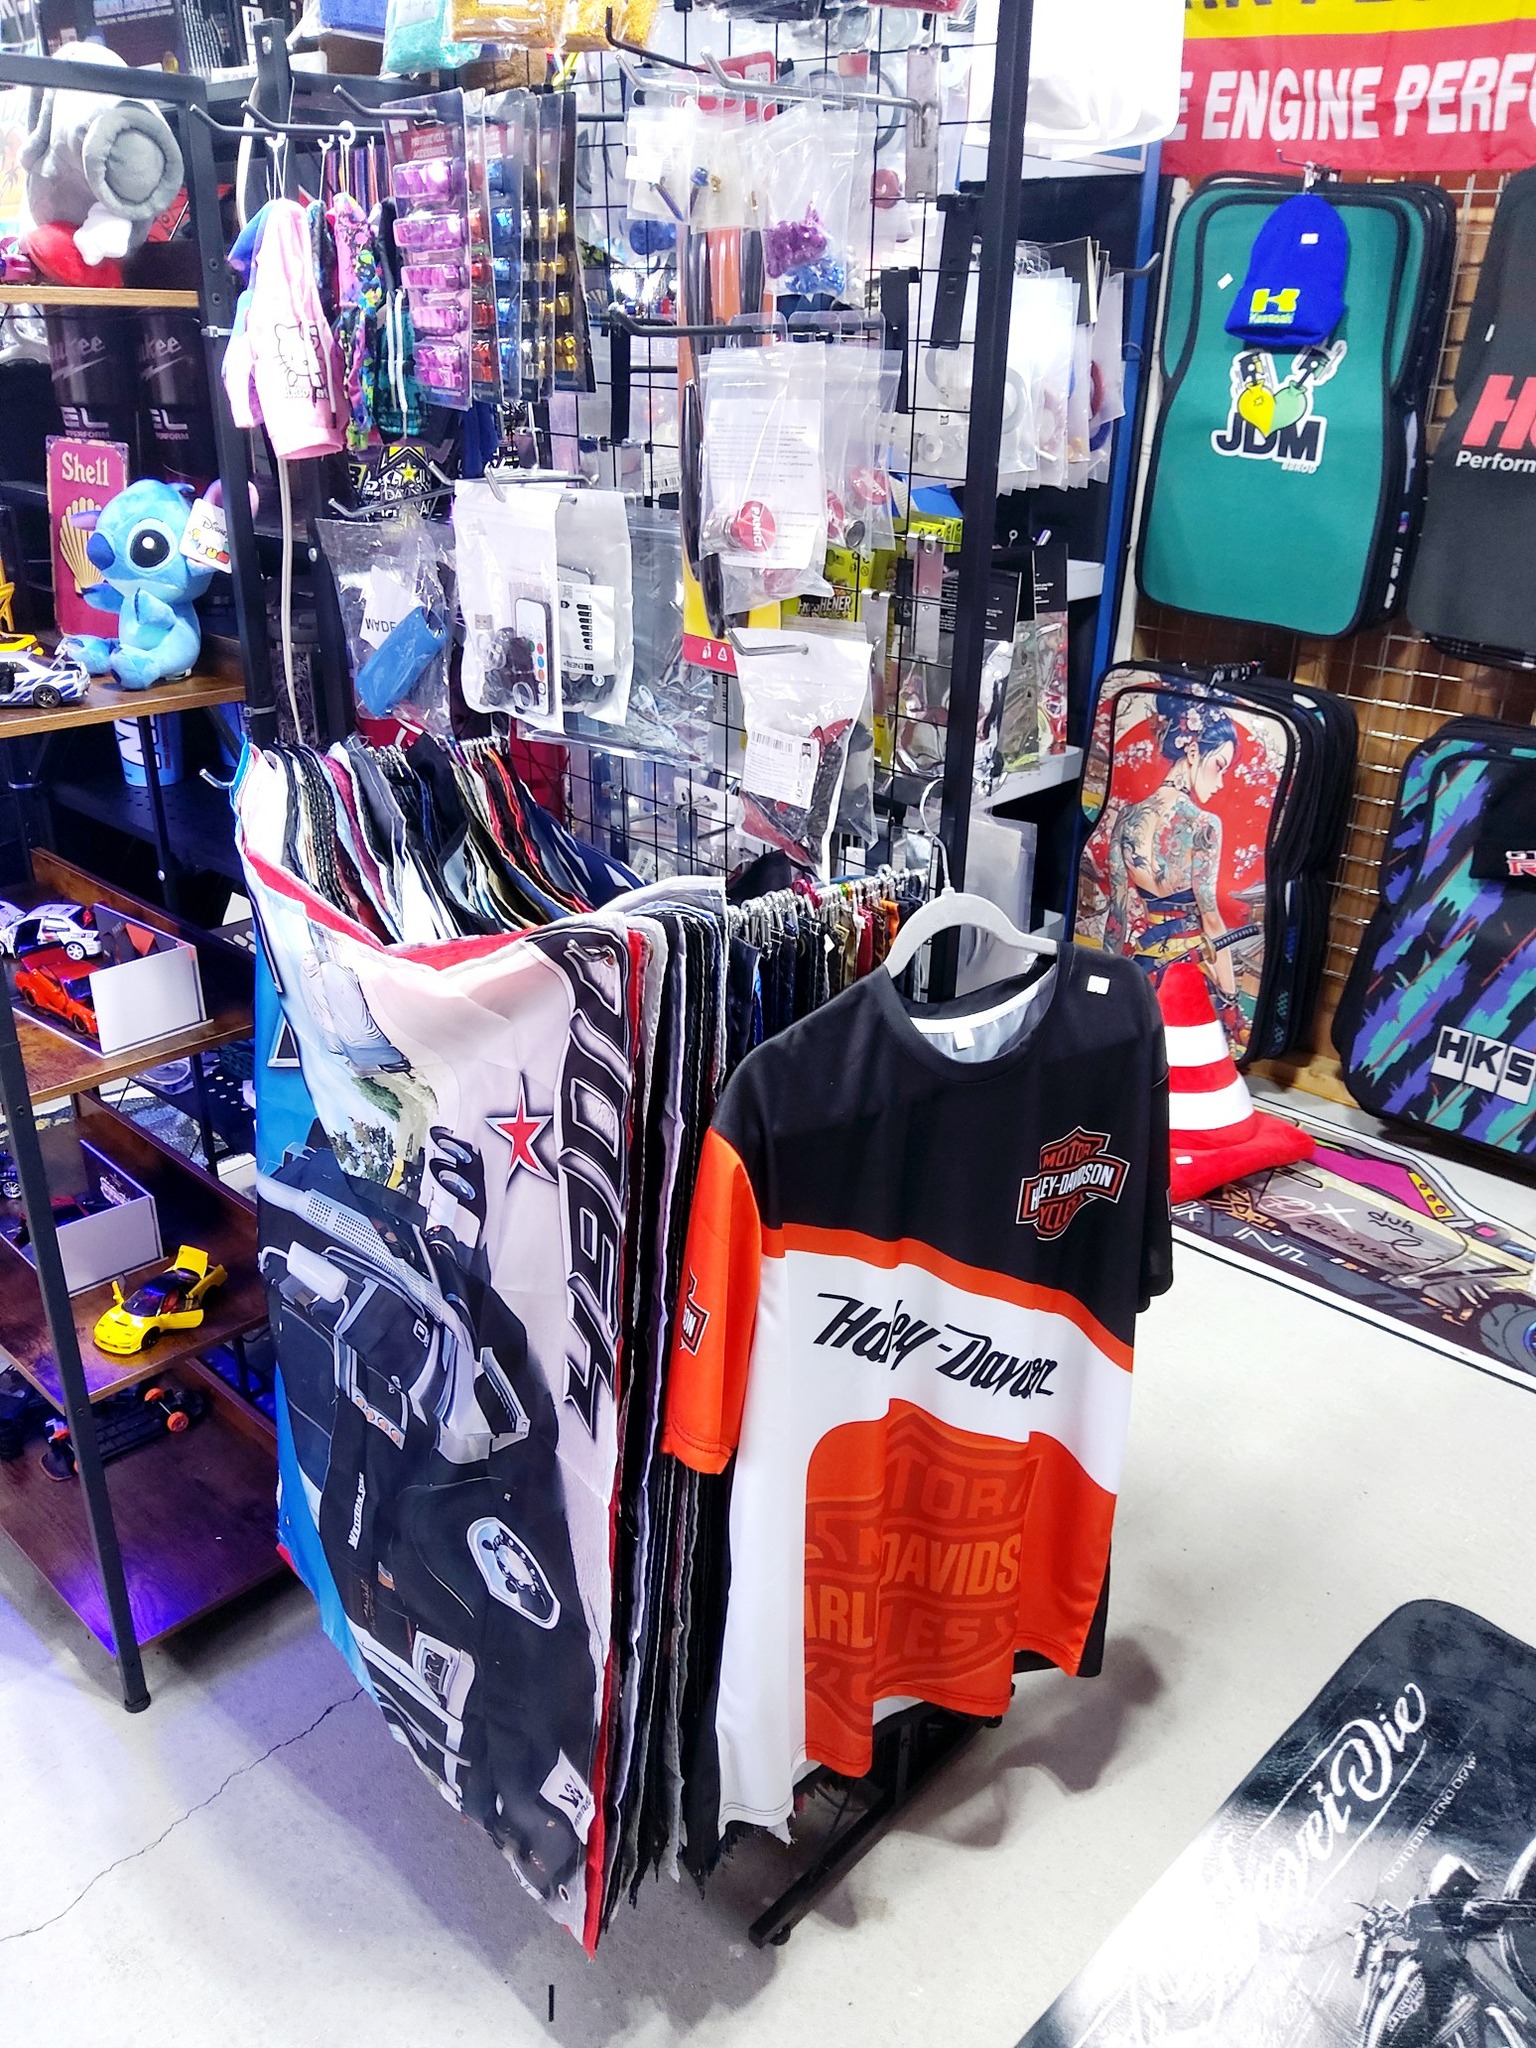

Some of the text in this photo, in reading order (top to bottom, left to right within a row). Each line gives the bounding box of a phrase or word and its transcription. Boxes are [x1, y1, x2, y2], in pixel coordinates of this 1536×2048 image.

[1202, 67, 1384, 141] ENGINE
[1215, 412, 1321, 462] JDM
[61, 451, 109, 487] Shell
[1437, 1030, 1536, 1088] HKS
[1043, 1140, 1092, 1168] MOTOR
